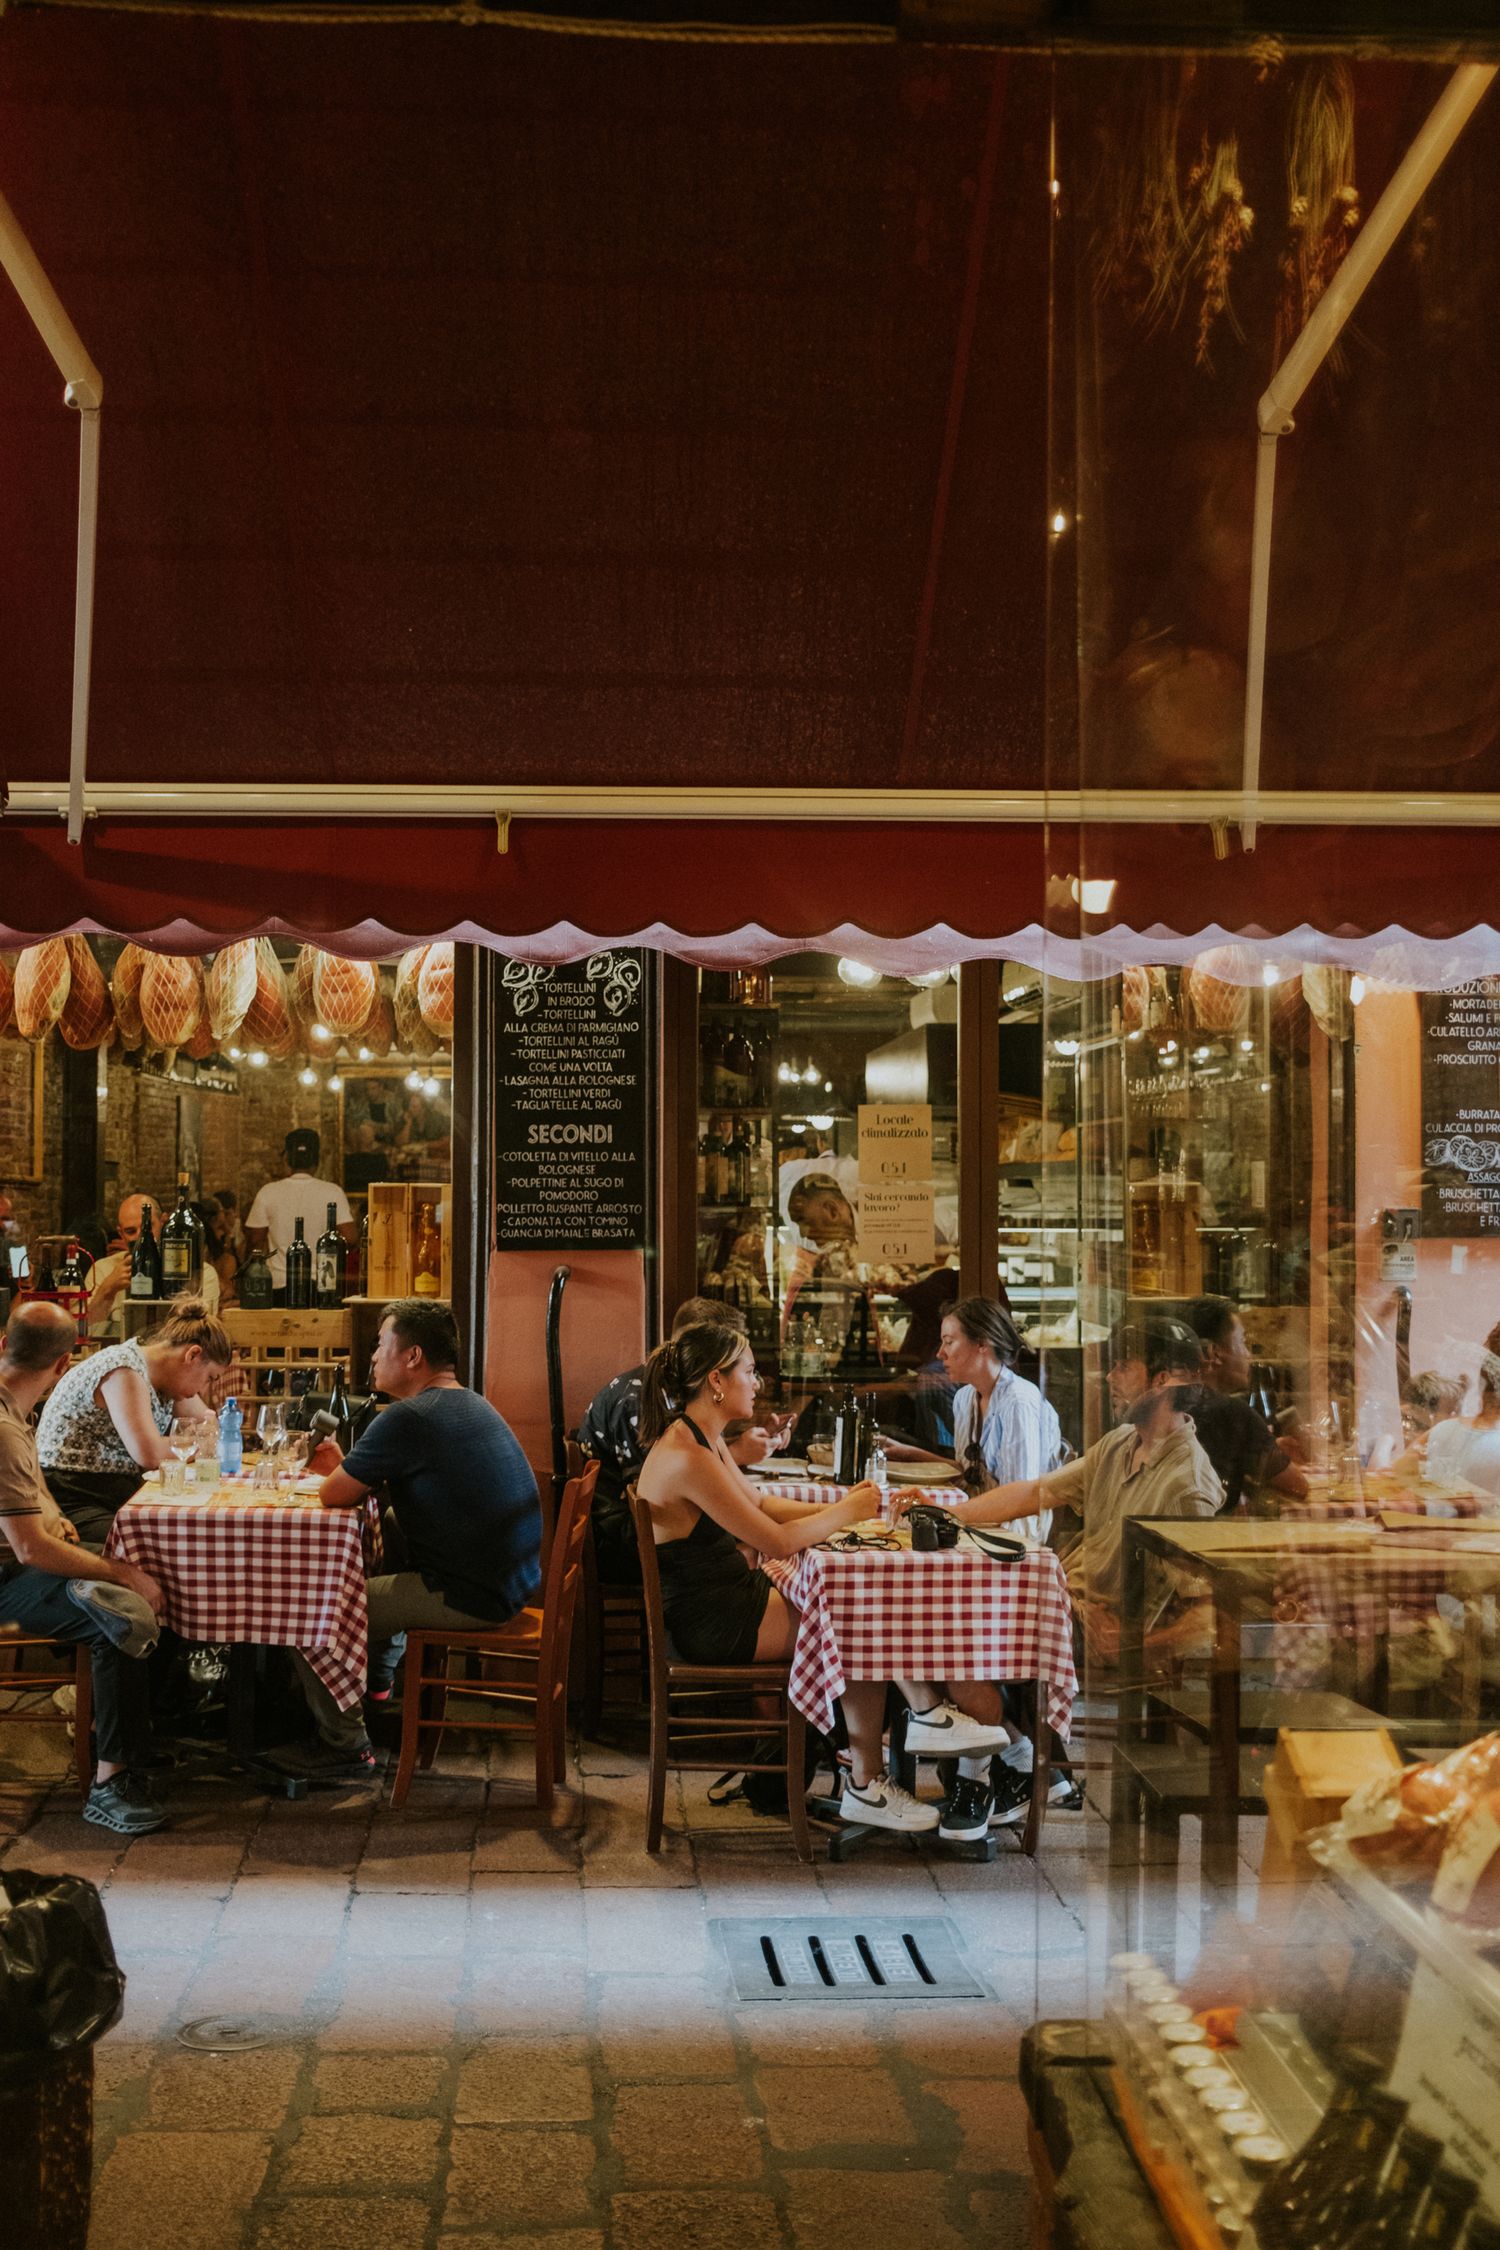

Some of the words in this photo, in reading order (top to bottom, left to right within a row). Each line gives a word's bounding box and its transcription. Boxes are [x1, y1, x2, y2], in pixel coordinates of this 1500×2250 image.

[547, 996, 557, 1006] IN
[559, 996, 595, 1006] BRODO
[1486, 1013, 1491, 1023] E
[504, 1023, 528, 1033] ALLA
[531, 1023, 563, 1033] CREMA
[566, 1023, 576, 1033] DI
[578, 1022, 639, 1033] PARMIGIANO
[577, 1036, 590, 1046] AL
[571, 1049, 625, 1059] PASTICCIATI
[529, 1062, 557, 1073] COME
[559, 1062, 581, 1072] UNA
[583, 1062, 613, 1072] VOLTA
[552, 1075, 577, 1086] ALLA
[579, 1075, 637, 1086] BOLOGNESE
[583, 1088, 611, 1099] VERDI
[581, 1100, 594, 1110] AL
[876, 1113, 914, 1125] Locale
[527, 1124, 613, 1144] SECONDI
[861, 1127, 929, 1138] climatizzato
[1425, 1123, 1472, 1134] CULACCIA
[1474, 1123, 1484, 1133] DI
[558, 1152, 569, 1162] DI
[570, 1152, 609, 1162] VITELLO
[611, 1152, 636, 1162] ALLA
[538, 1164, 596, 1175] BOLOGNESE
[569, 1177, 581, 1188] AL
[584, 1177, 613, 1188] SUGO
[614, 1177, 625, 1188] DI
[539, 1190, 599, 1201] POMODORO
[864, 1192, 882, 1201] Stai
[884, 1192, 929, 1201] cercando
[547, 1203, 593, 1213] RUSPANTE
[595, 1203, 642, 1214] ARROSTO
[564, 1216, 586, 1226] CON
[588, 1216, 628, 1226] TOMINO
[1480, 1215, 1486, 1227] E
[544, 1229, 554, 1238] DI
[555, 1229, 590, 1238] MAIALE
[591, 1228, 636, 1238] BRASATA
